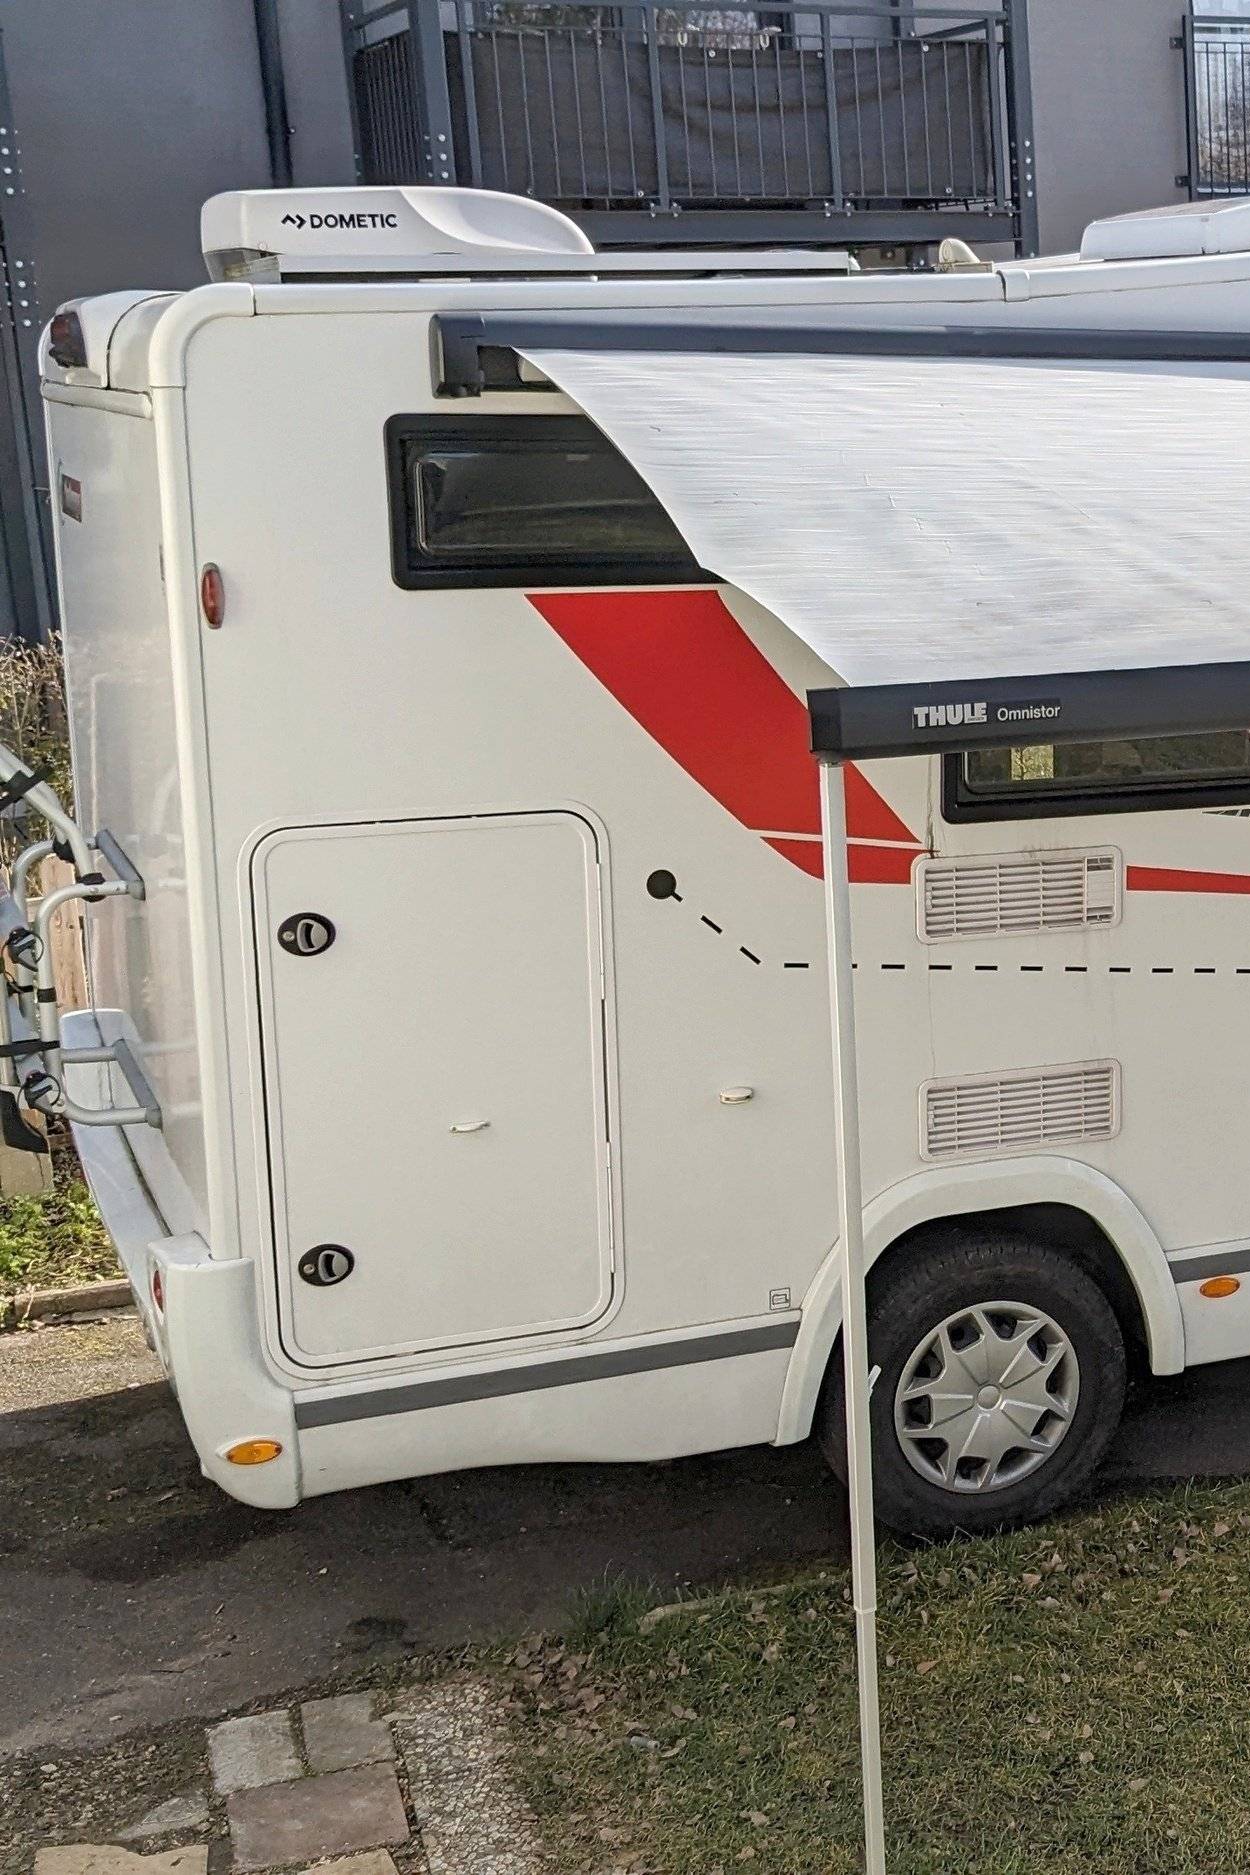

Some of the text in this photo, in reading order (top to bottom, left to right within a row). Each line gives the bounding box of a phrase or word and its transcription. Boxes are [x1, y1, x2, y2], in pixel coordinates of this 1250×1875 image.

[310, 214, 398, 229] DOMETIC
[913, 702, 1060, 728] THULE Omnistor
